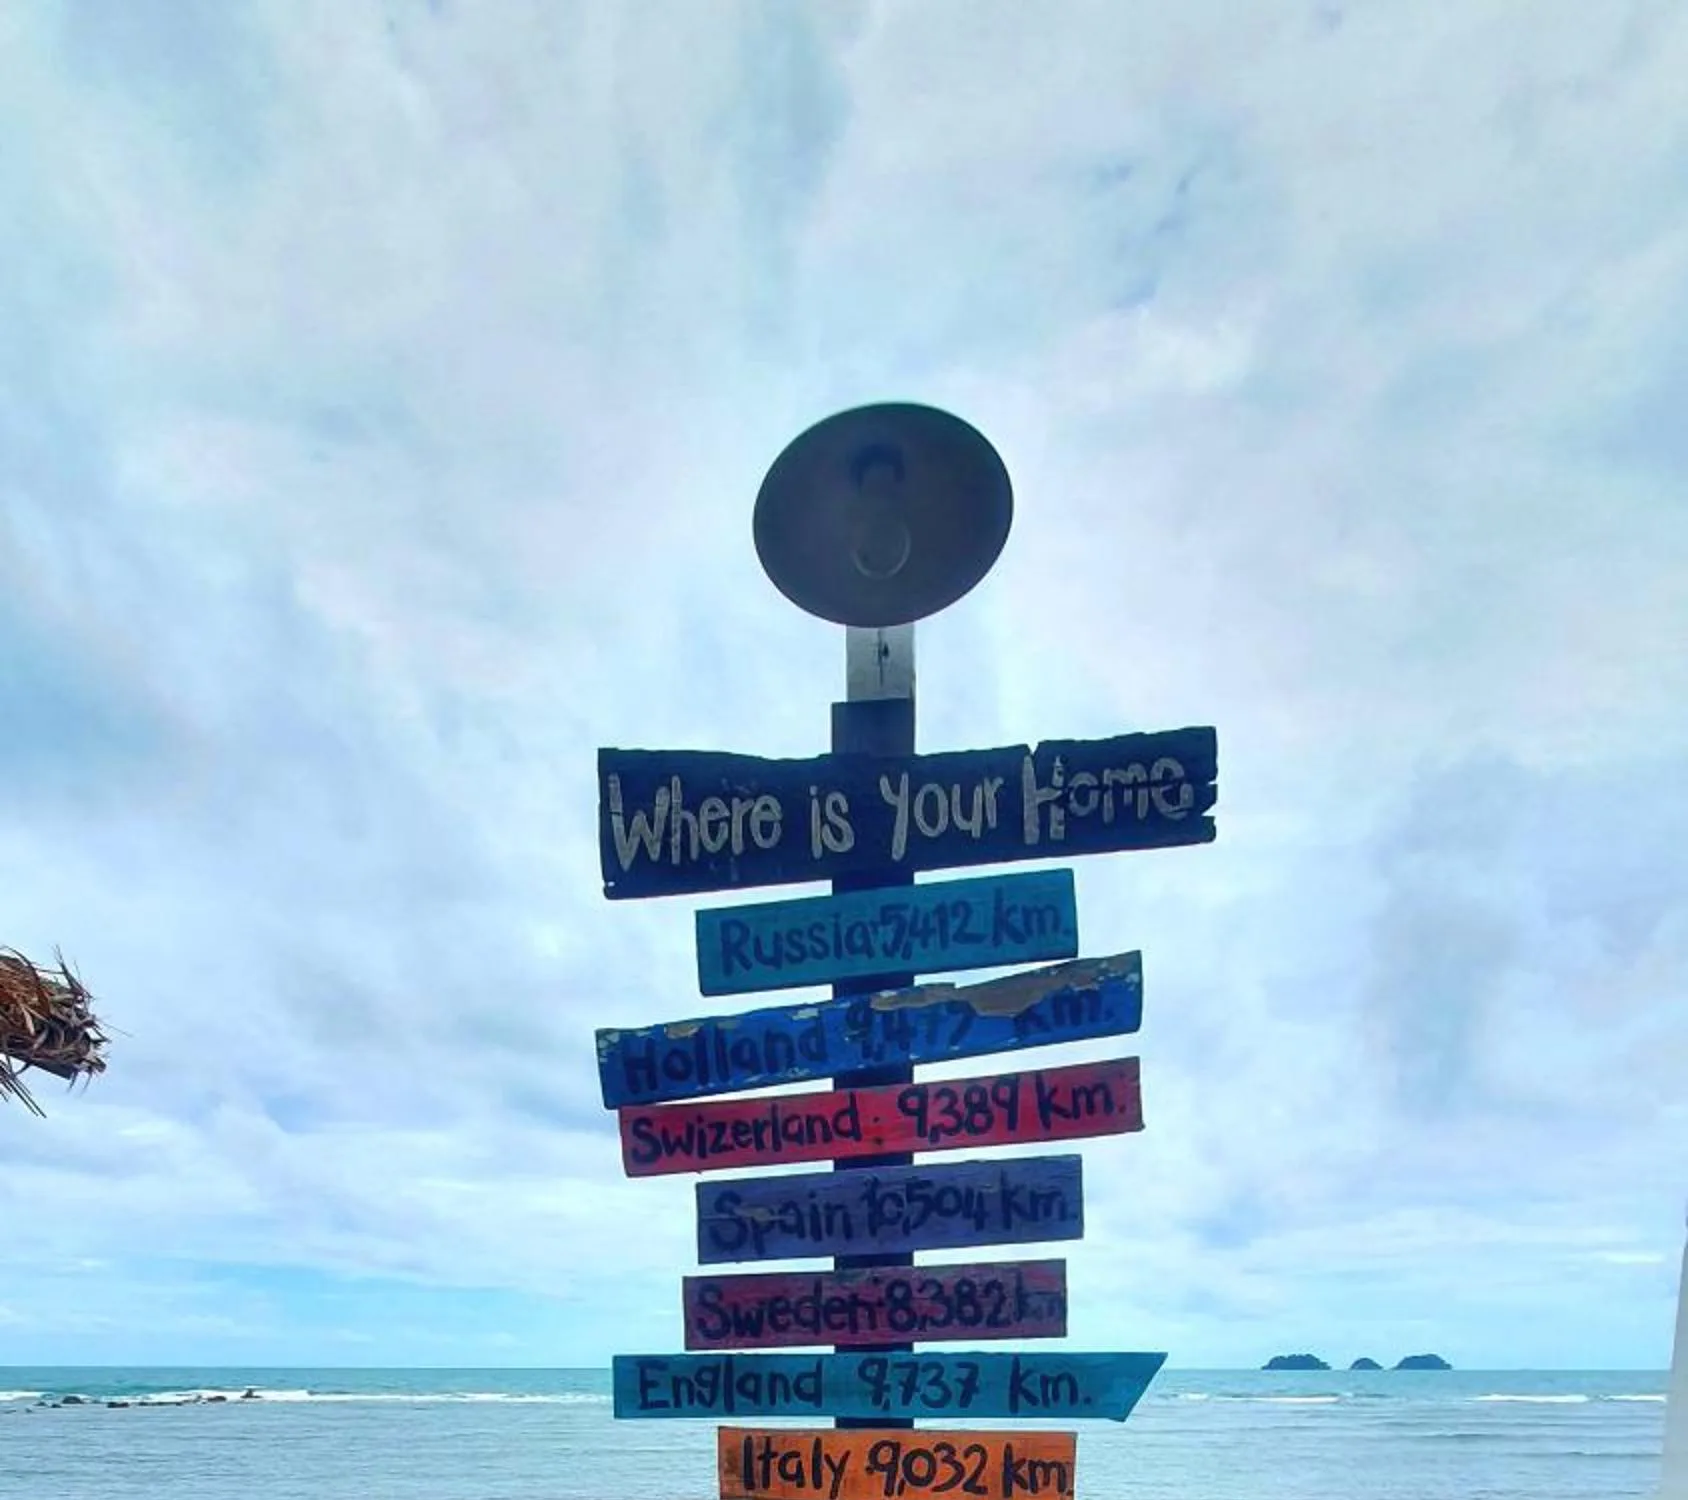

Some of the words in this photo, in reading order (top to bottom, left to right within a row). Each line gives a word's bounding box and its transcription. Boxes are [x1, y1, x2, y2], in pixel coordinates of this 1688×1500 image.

[608, 772, 783, 870] Where
[810, 786, 855, 859] is
[1023, 754, 1192, 845] Home
[991, 888, 1071, 947] km.
[623, 1022, 828, 1095] Holland
[897, 1074, 1020, 1144] 9,389
[710, 1190, 853, 1257] Spain
[638, 1353, 824, 1412] England
[858, 1356, 982, 1412] 9,737
[743, 1436, 850, 1500] Italy
[867, 1439, 989, 1498] 9,032
